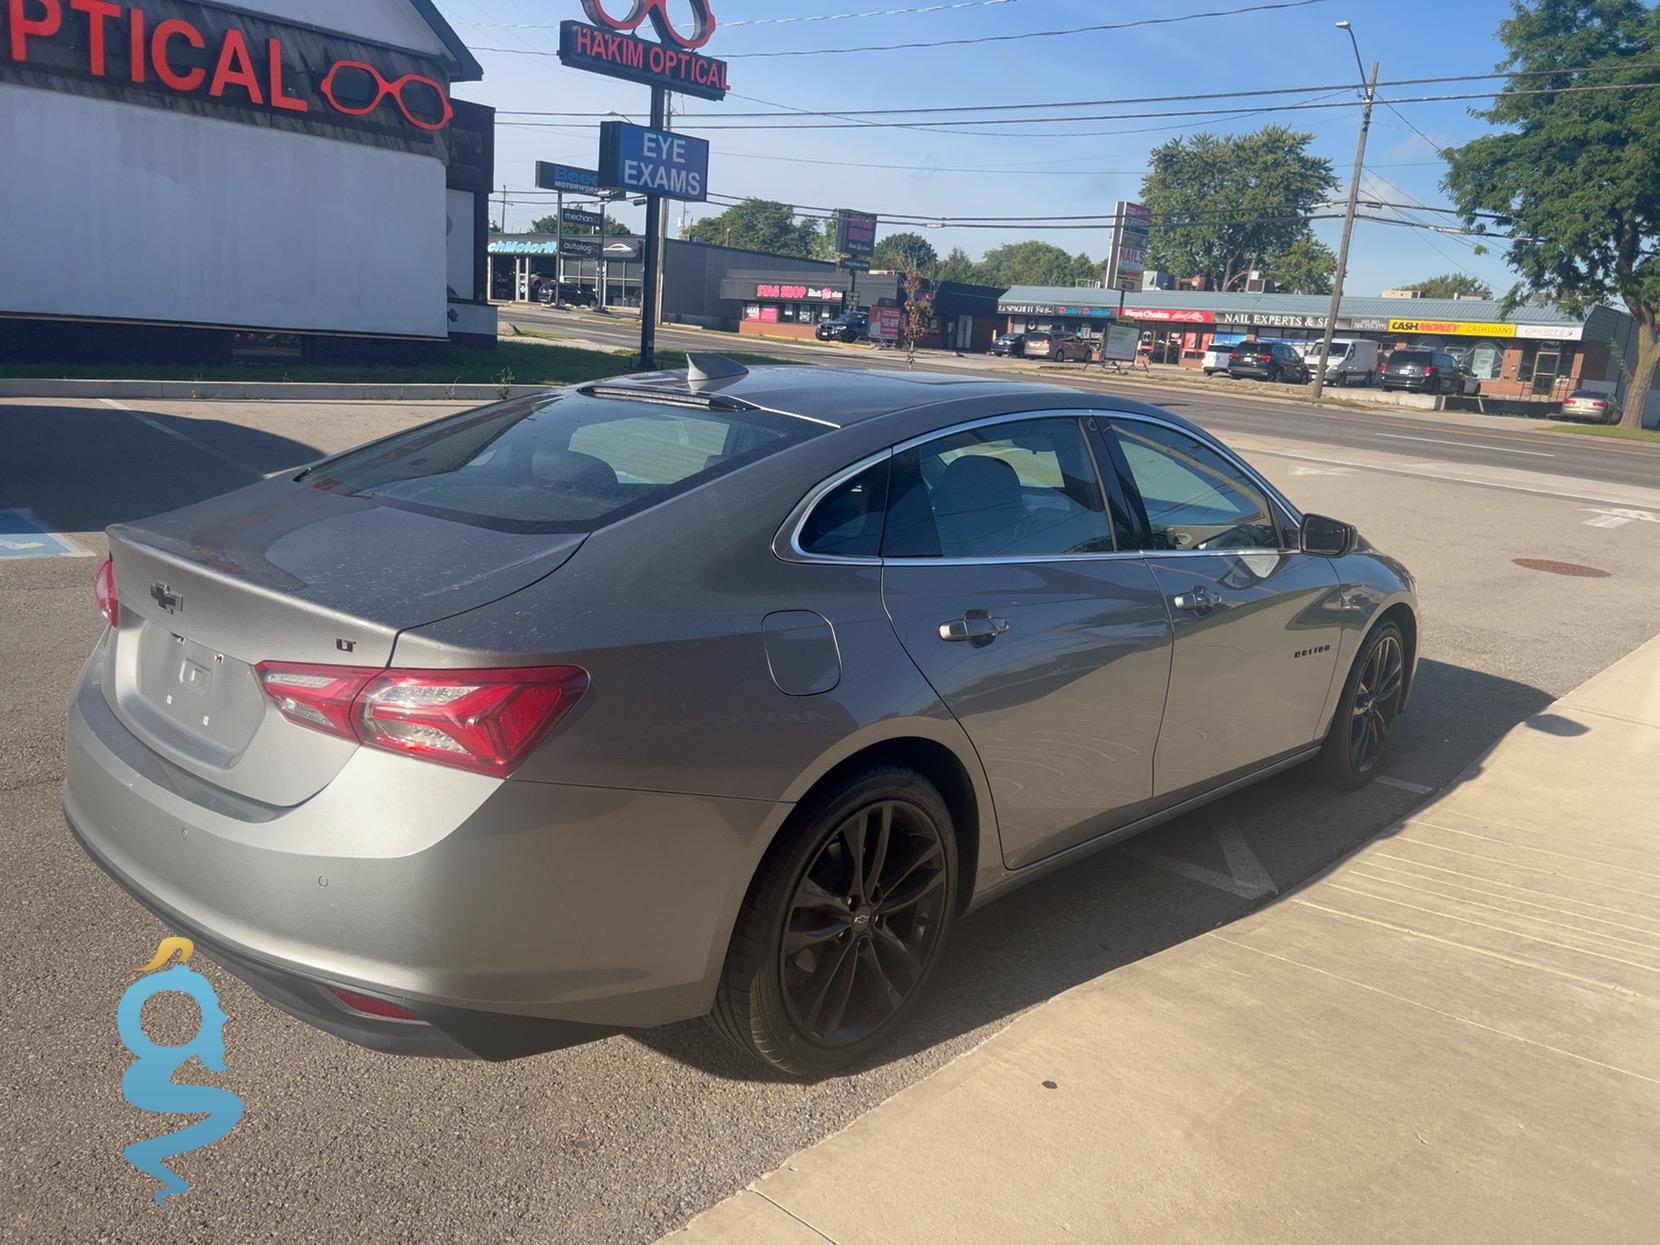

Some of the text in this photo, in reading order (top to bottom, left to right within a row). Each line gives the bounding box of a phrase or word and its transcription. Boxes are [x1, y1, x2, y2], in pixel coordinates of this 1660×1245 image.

[8, 0, 309, 112] PTICAL
[573, 26, 731, 90] HAKIM OPTICAL
[643, 132, 686, 163] EYE
[623, 159, 700, 195] EXAMS
[1119, 247, 1145, 264] NAILS
[1224, 313, 1250, 324] NAIL
[1253, 315, 1302, 327] EXPERTS
[1304, 317, 1314, 327] &
[1391, 321, 1419, 331] CASH
[1418, 322, 1459, 334] MONEY
[1488, 326, 1513, 334] LOANS
[336, 638, 357, 653] LT
